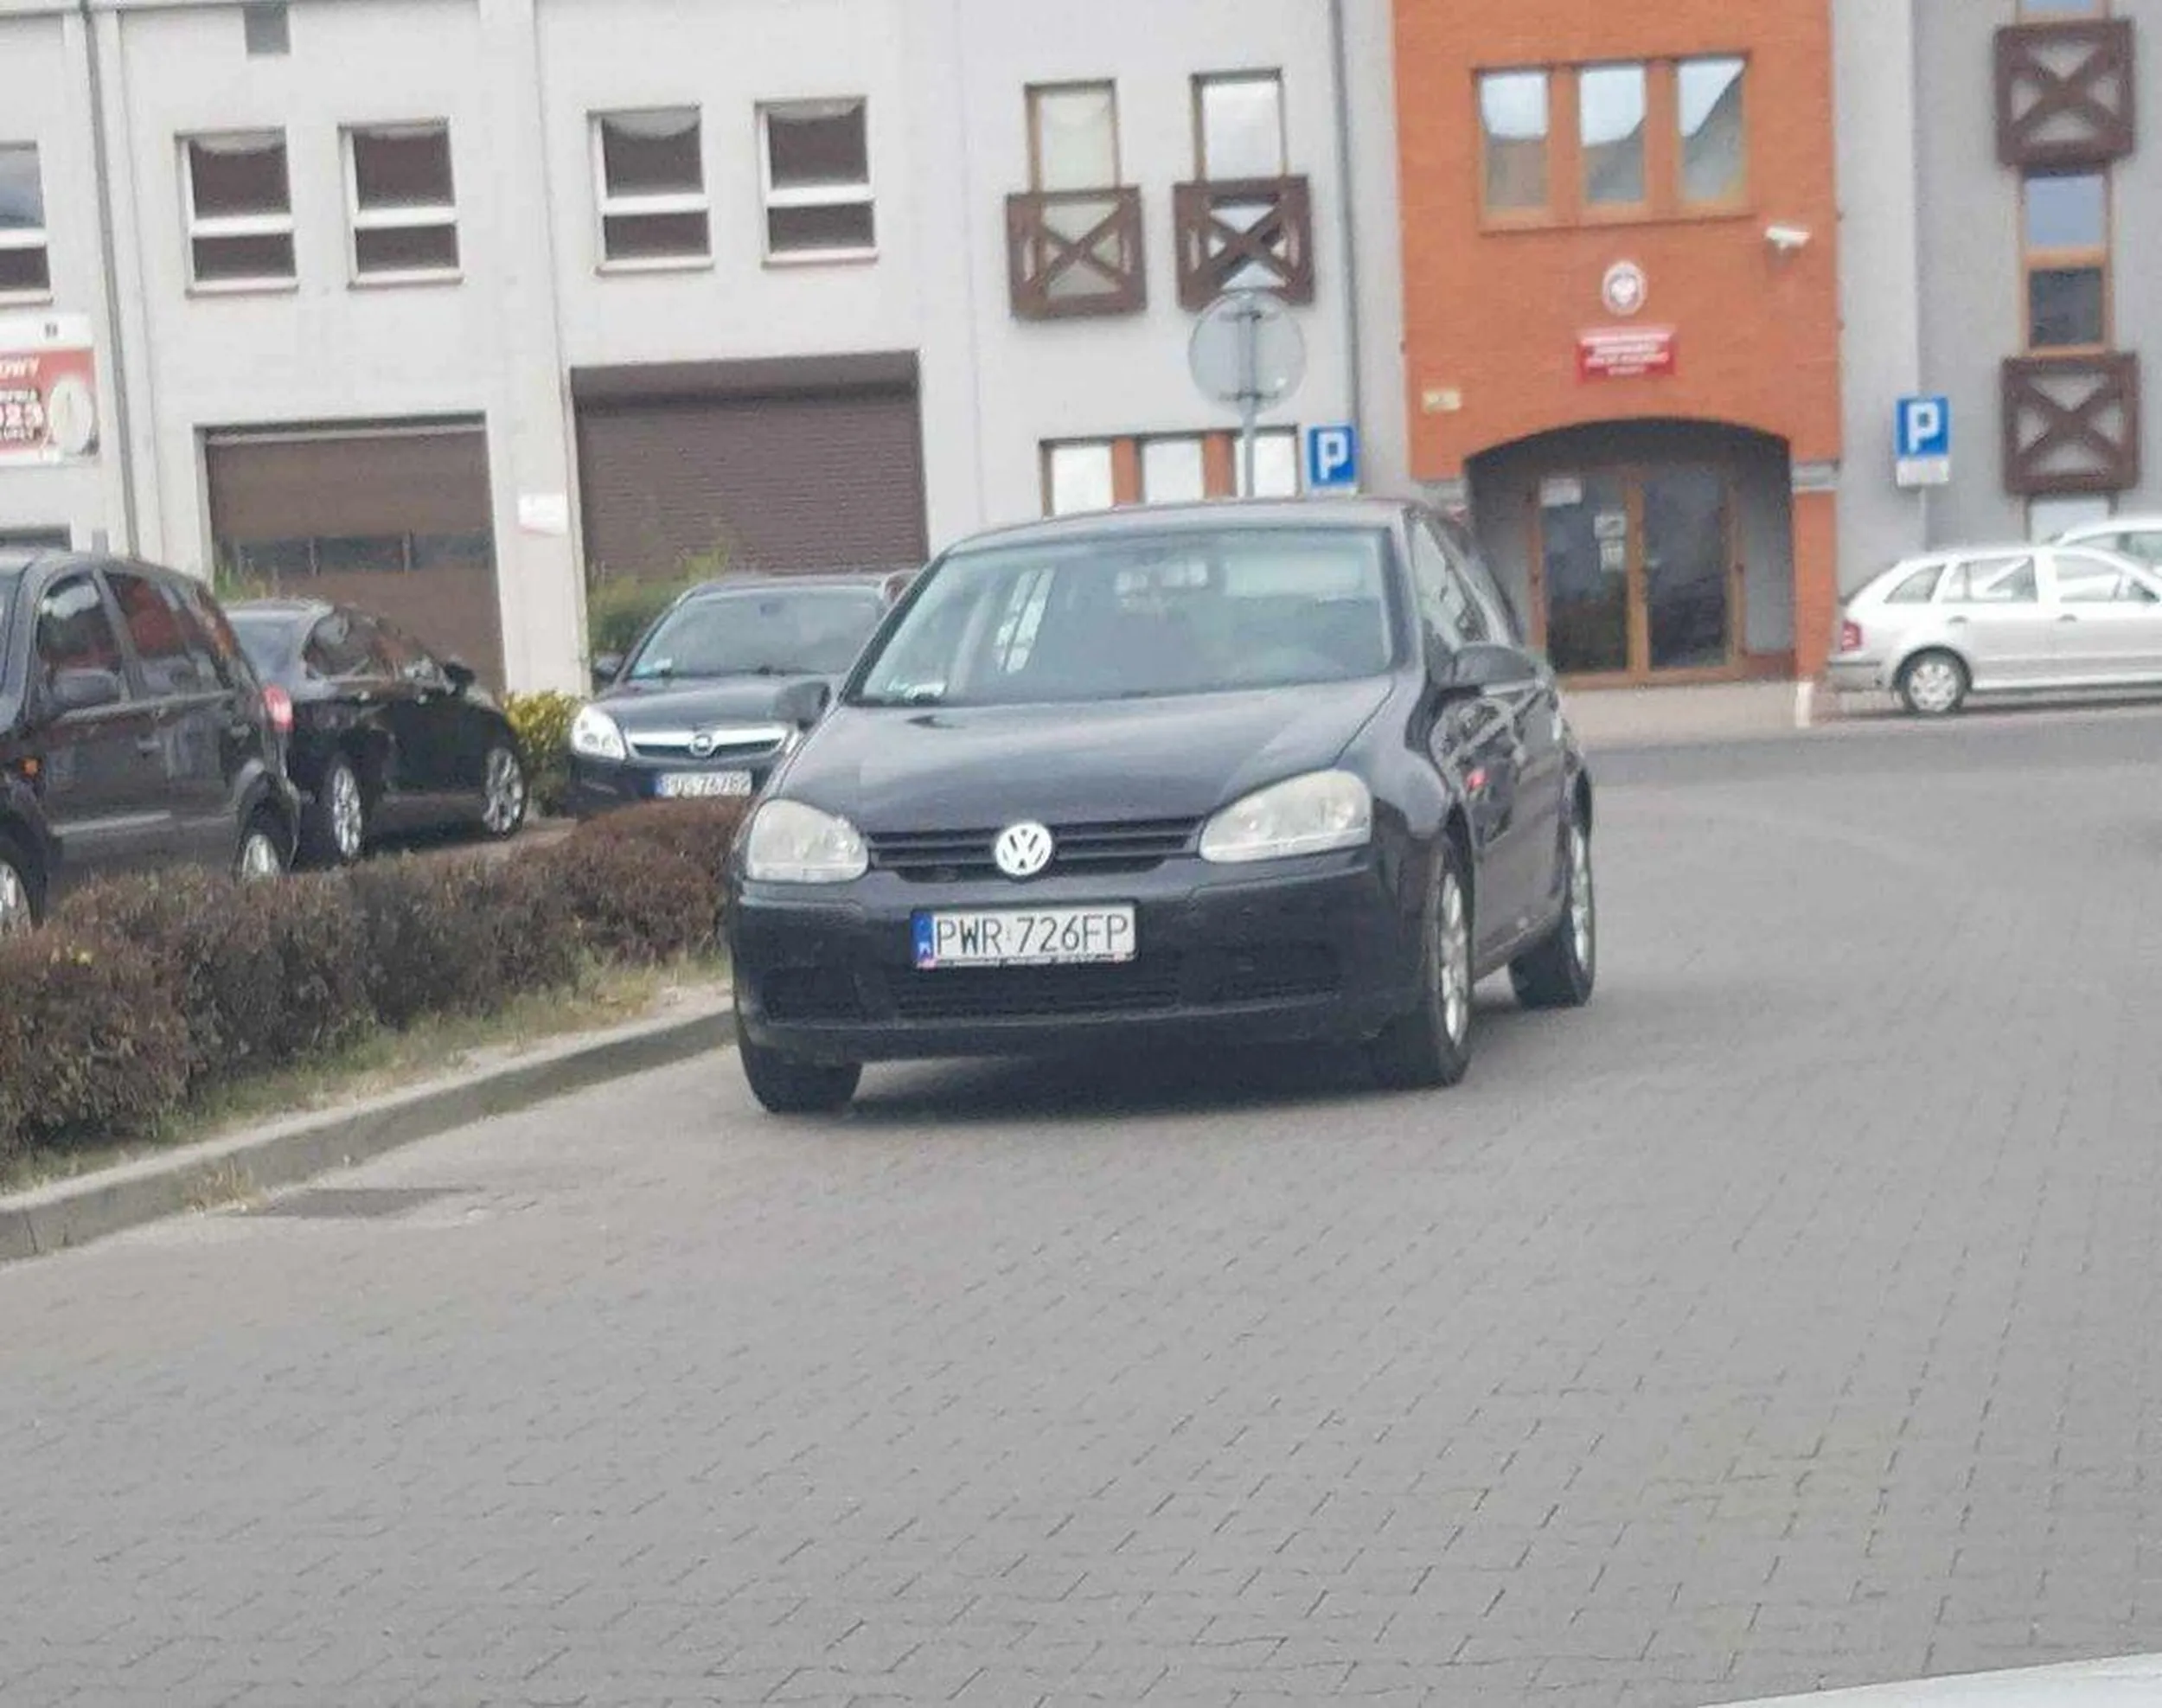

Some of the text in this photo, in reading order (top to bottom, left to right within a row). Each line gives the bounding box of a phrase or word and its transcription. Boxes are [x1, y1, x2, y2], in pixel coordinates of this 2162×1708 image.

[1907, 403, 1940, 454] P
[1317, 432, 1347, 480] P
[937, 914, 1129, 955] PWR 726FP
